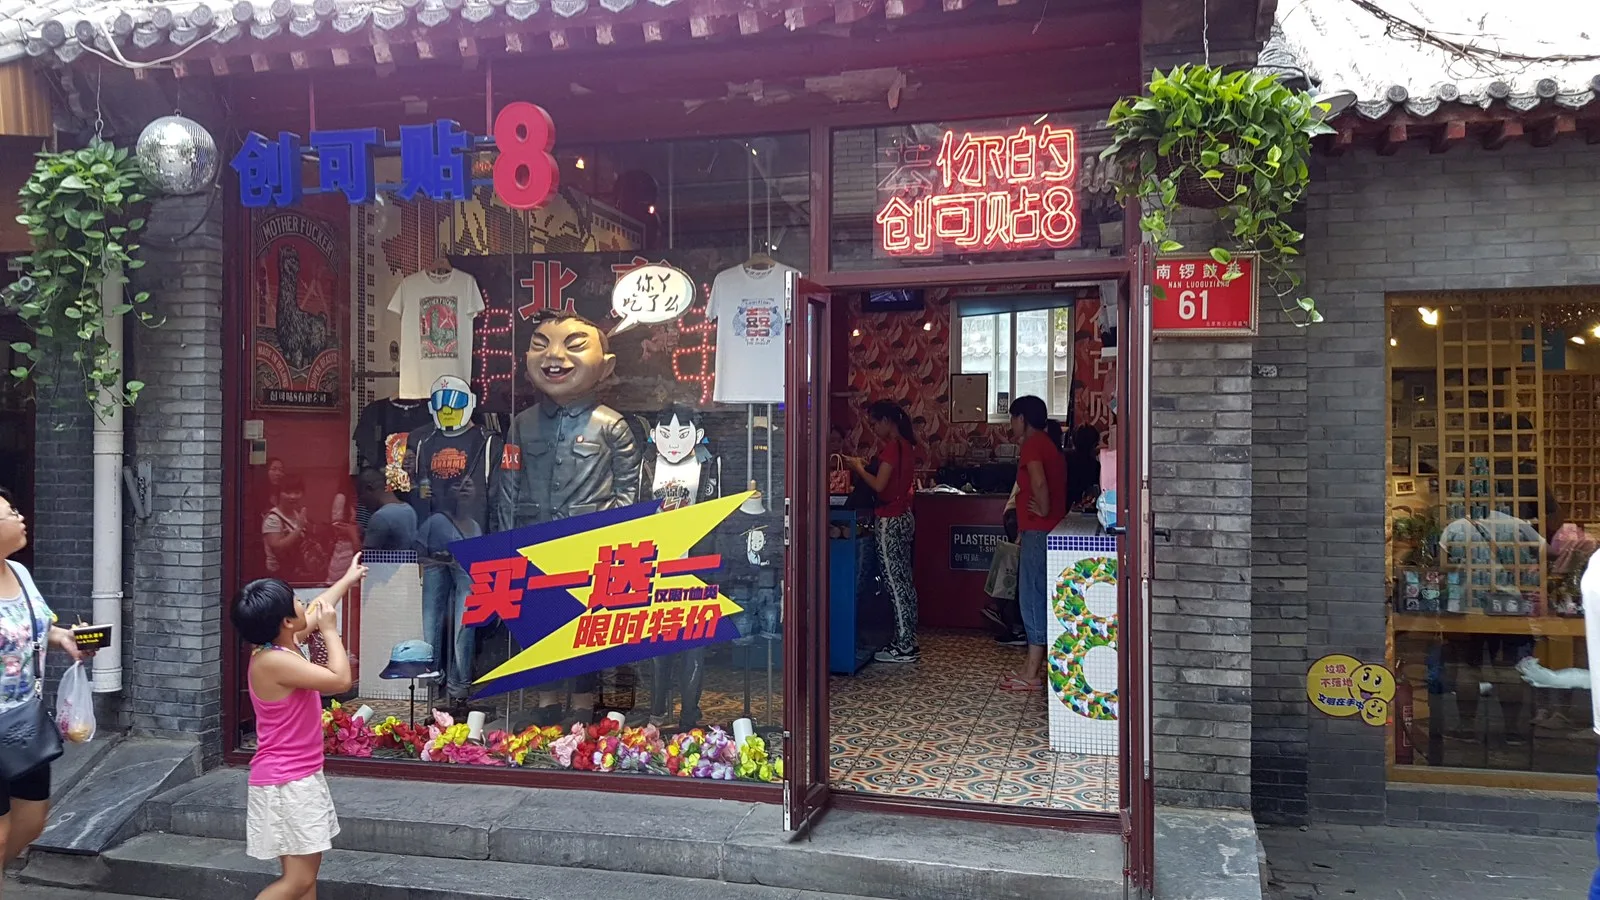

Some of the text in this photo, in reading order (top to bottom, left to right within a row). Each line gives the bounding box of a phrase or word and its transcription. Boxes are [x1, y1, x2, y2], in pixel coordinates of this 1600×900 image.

[230, 102, 559, 209] 创可贴8
[876, 186, 1076, 251] 创可贴8
[262, 215, 335, 257] MOTHER FUCKER
[636, 272, 671, 293] 你丫
[1168, 280, 1230, 289] NAN LUOGUXIANG
[622, 294, 679, 312] 吃了么
[1178, 289, 1209, 320] 61
[954, 533, 1009, 546] PLASTERED
[461, 540, 722, 626] 买一送一
[573, 603, 723, 649] 限时特价
[1325, 664, 1347, 674] 垃圾
[1320, 677, 1354, 688] 不落地
